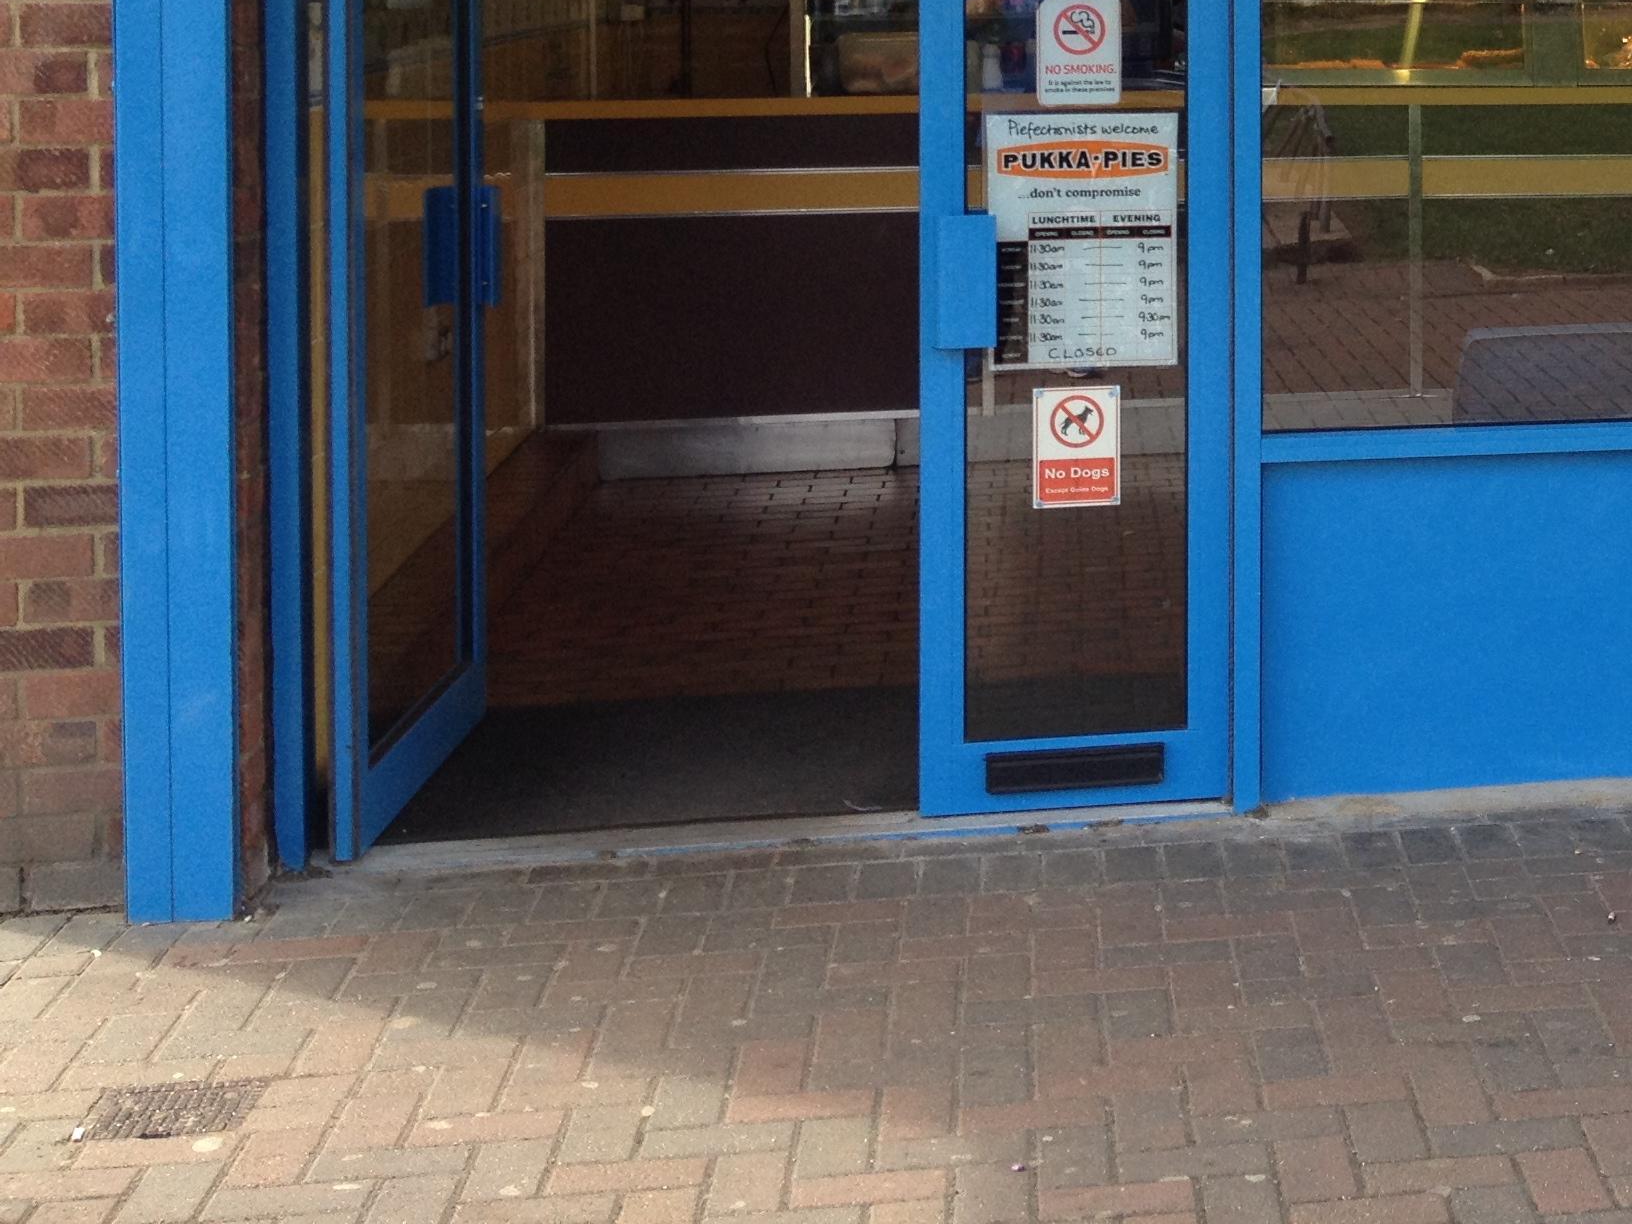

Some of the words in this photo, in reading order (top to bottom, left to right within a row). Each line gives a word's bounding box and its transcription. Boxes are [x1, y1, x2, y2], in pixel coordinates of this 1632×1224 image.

[1045, 64, 1061, 75] NO
[1101, 123, 1159, 135] welcome
[1065, 186, 1141, 200] compromise
[1032, 215, 1097, 224] LUNCHTIME
[1113, 214, 1161, 223] EVENING
[1045, 468, 1066, 479] No
[1070, 467, 1110, 480] Dogs
